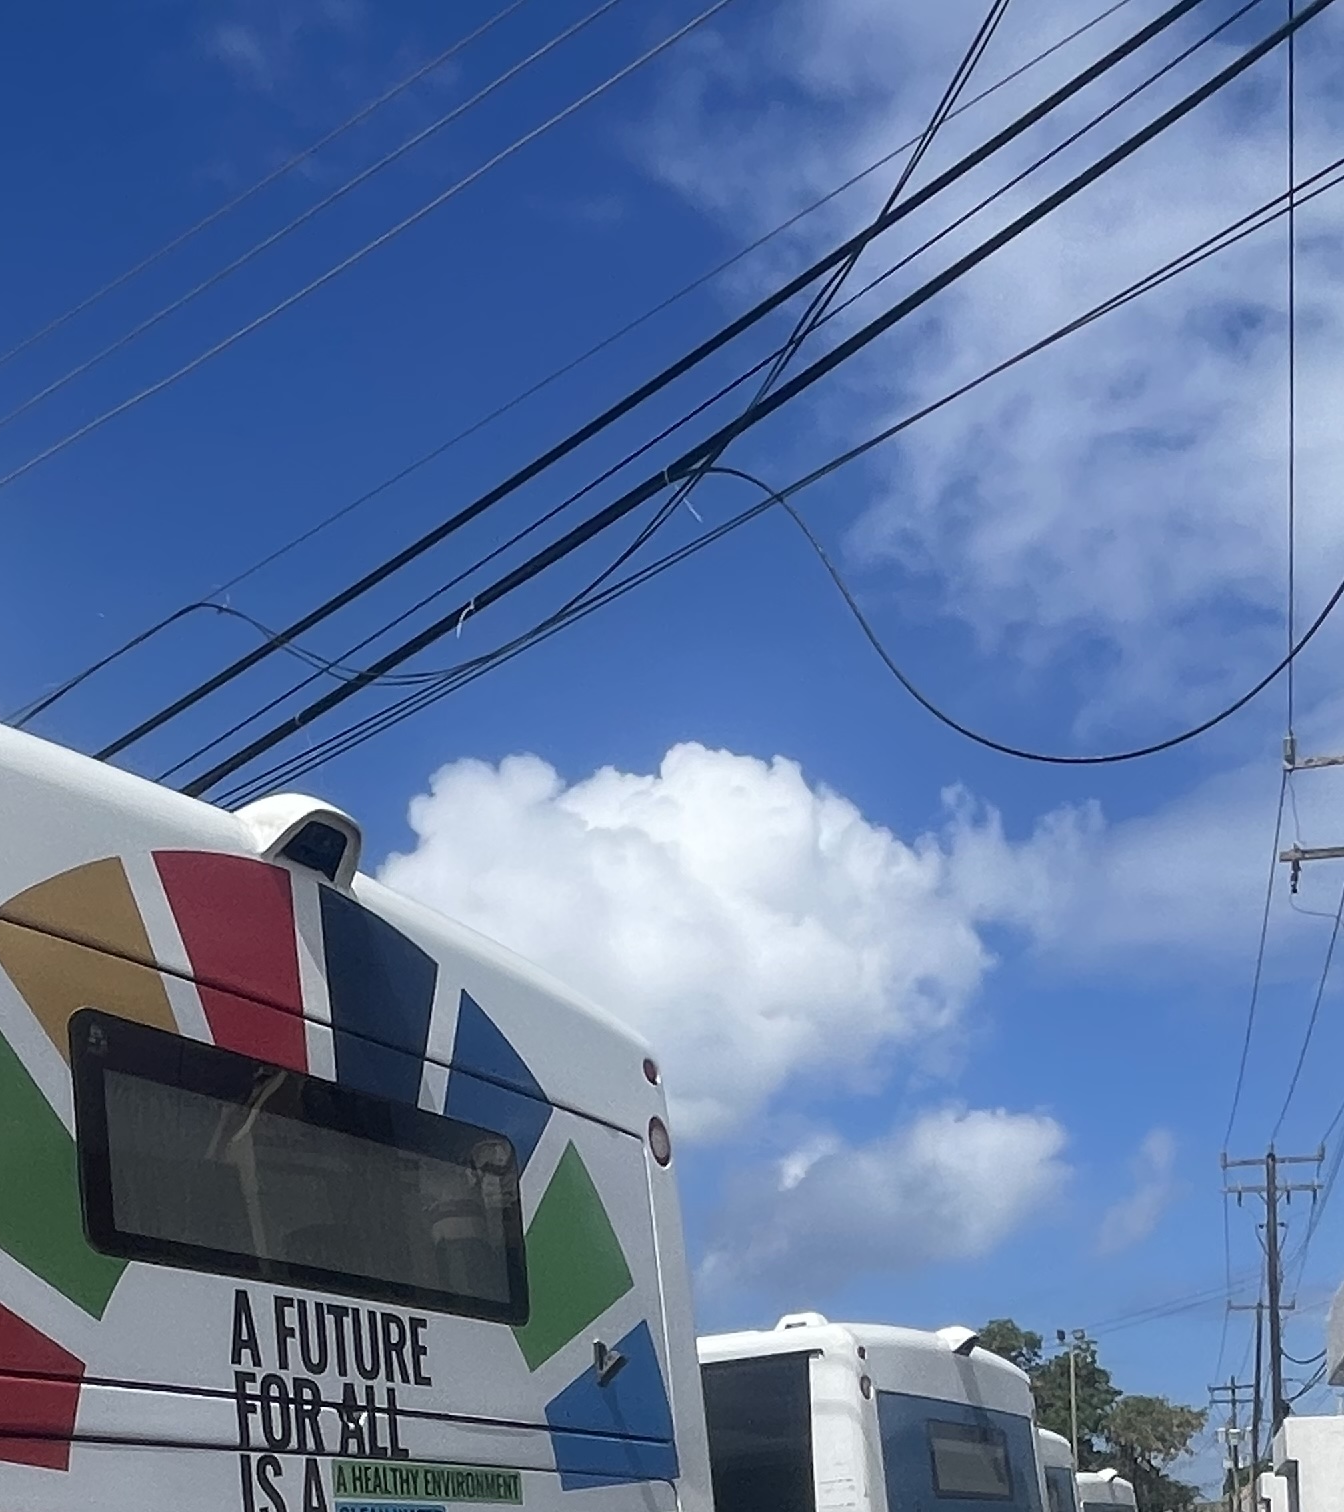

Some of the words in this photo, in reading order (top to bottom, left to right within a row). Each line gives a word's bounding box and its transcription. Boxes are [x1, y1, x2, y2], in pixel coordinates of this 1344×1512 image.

[231, 1289, 262, 1368] A
[273, 1294, 432, 1387] FUTURE
[234, 1371, 325, 1454] FOR
[339, 1382, 409, 1459] ALL
[336, 1465, 348, 1493] A
[352, 1465, 420, 1496] HEALTHY
[424, 1469, 519, 1499] ENVIRONMENT
